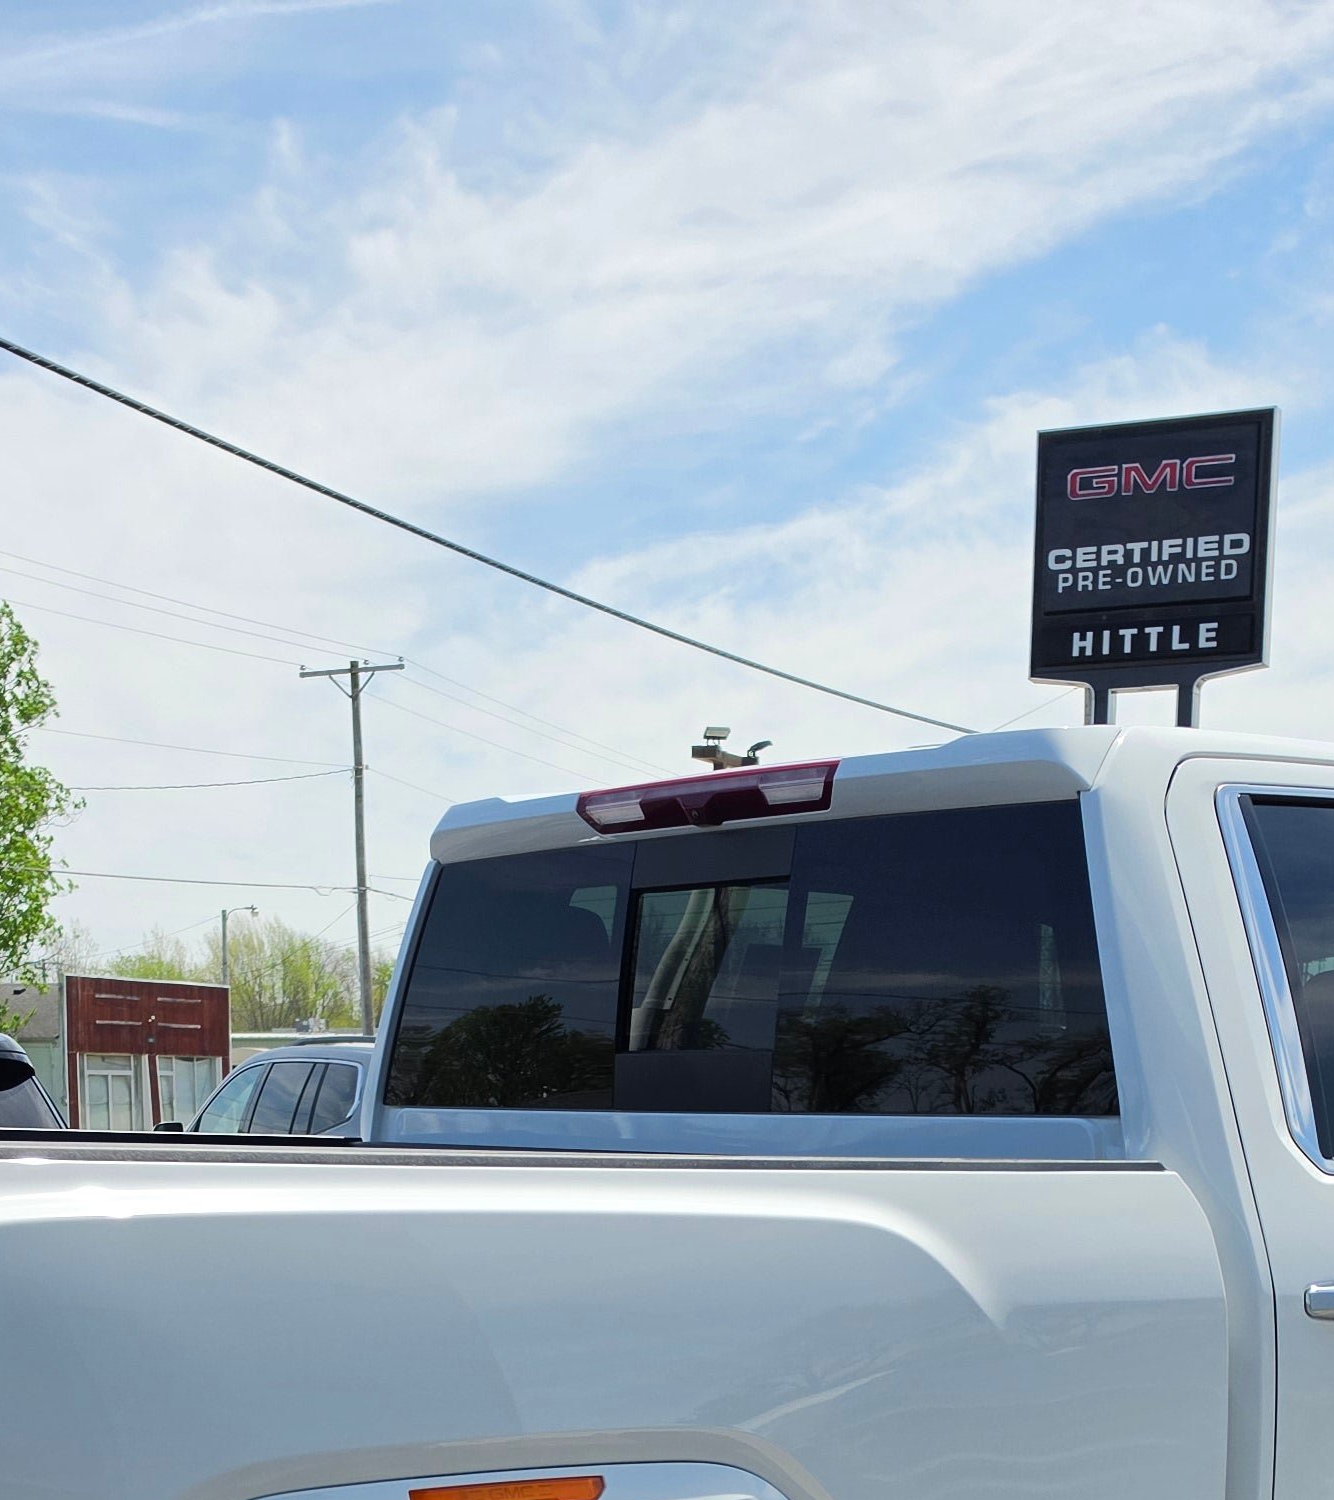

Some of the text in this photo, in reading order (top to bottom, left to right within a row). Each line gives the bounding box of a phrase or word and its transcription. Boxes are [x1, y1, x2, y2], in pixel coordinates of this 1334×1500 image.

[1068, 454, 1236, 500] GMC
[1047, 532, 1251, 571] CERTIFIED
[1057, 559, 1238, 593] PRE-OWNED
[1071, 622, 1219, 657] HITTLE
